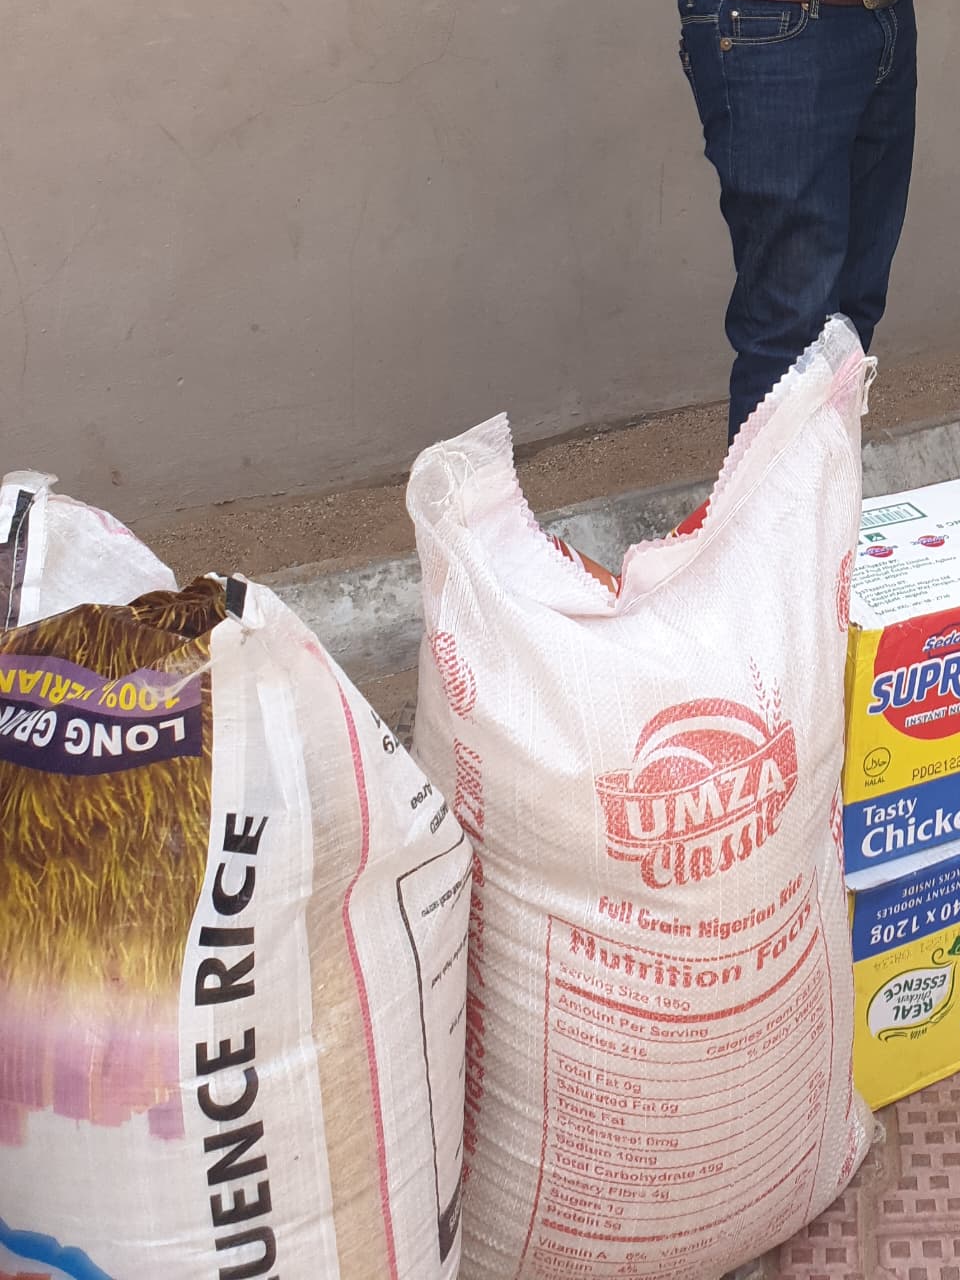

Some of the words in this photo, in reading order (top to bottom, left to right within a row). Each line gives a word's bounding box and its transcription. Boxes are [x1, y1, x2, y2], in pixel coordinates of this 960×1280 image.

[905, 708, 947, 728] INSTANT
[64, 716, 186, 757] LONG
[865, 777, 886, 788] HALAL
[625, 758, 787, 839] UMZA
[863, 797, 918, 827] Tasty
[640, 800, 783, 889] Classic
[902, 876, 937, 892] INSIDE
[194, 812, 269, 1007] RICE
[598, 896, 633, 924] Full
[638, 908, 691, 938] Grain
[699, 902, 776, 940] Nigerian
[876, 896, 922, 920] NOODLES
[870, 916, 922, 946] 120g
[570, 927, 742, 989] Nutrition
[560, 962, 614, 995] Serving
[618, 984, 650, 1004] Size
[884, 974, 946, 1002] ESSENCE
[558, 994, 616, 1024] Amount
[620, 1019, 645, 1034] Per
[650, 1026, 709, 1039] Serving
[894, 999, 933, 1022] REAL
[556, 1019, 616, 1050] Calories
[706, 1030, 762, 1056] Calories
[766, 1005, 793, 1032] from
[762, 1026, 792, 1052] Daily
[556, 1058, 592, 1082] Total
[596, 1074, 619, 1088] Fat
[557, 1078, 628, 1109] Saturated
[632, 1101, 656, 1112] Fat
[557, 1098, 596, 1120] Trans
[601, 1113, 626, 1126] Fat
[195, 1026, 280, 1280] UENCE
[554, 1151, 590, 1172] Total
[594, 1166, 696, 1187] Carbohydrate
[546, 1204, 600, 1228] Protein
[538, 1236, 593, 1259] Vitamin
